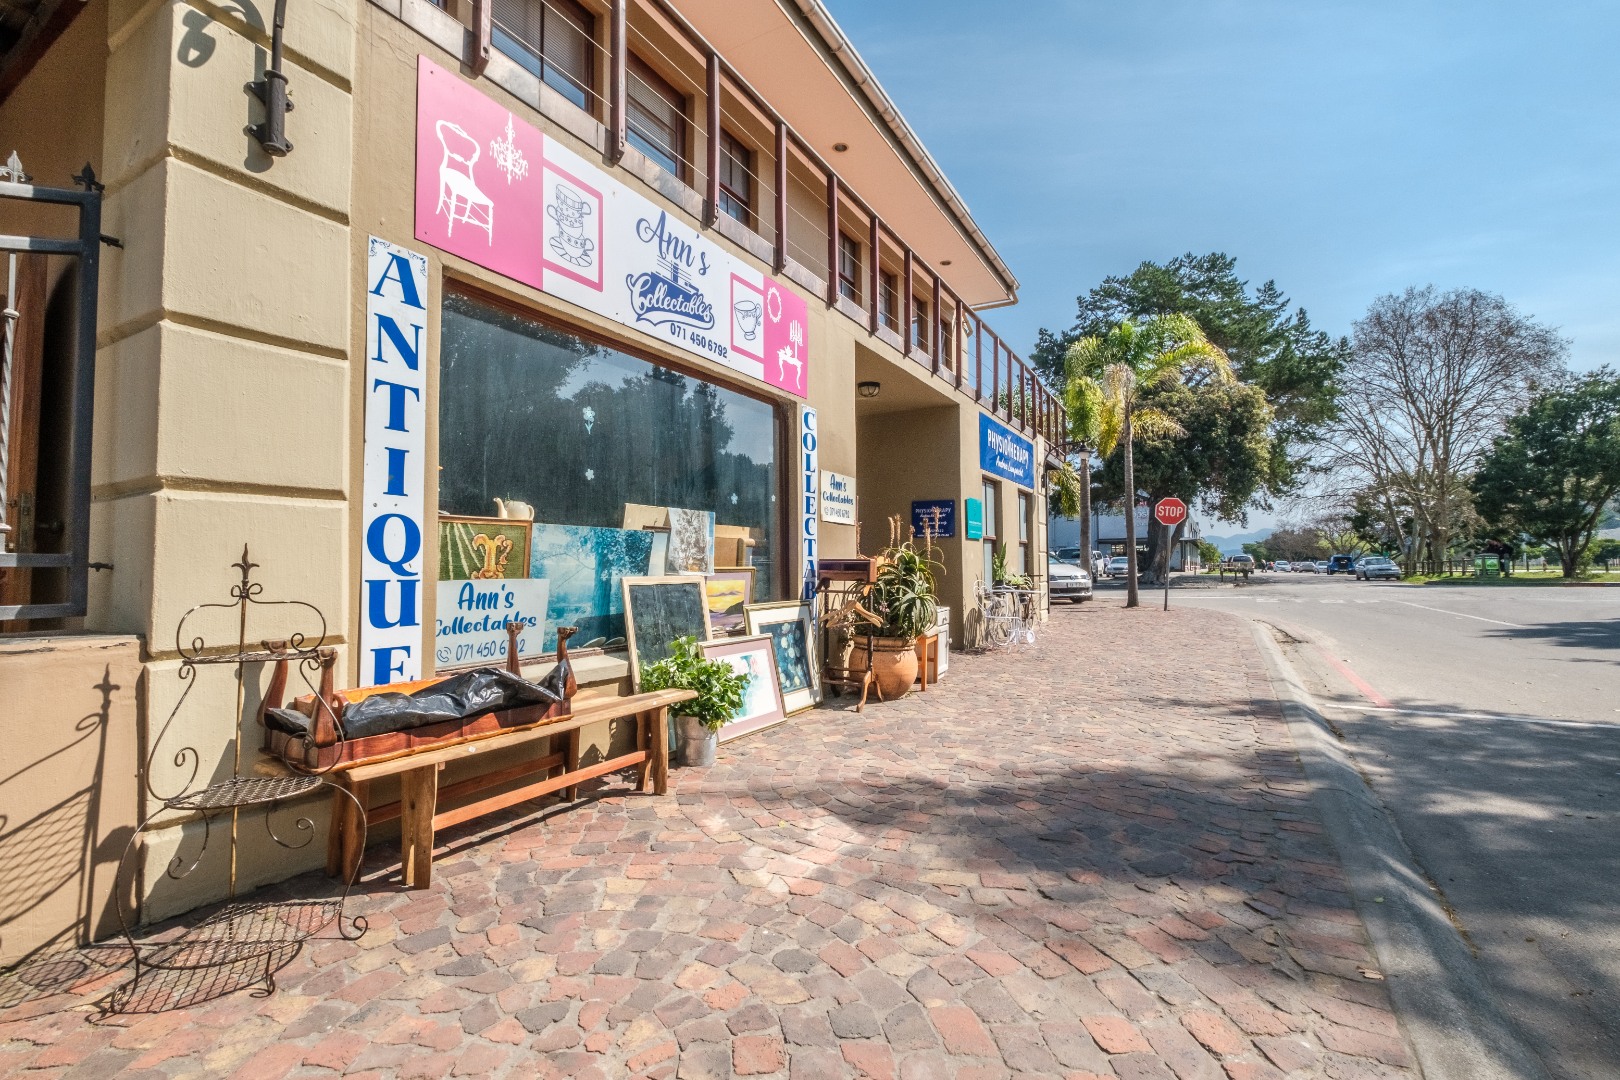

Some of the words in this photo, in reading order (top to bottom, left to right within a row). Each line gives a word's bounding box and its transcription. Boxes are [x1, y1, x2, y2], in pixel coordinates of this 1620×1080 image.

[636, 210, 710, 276] Ann's
[626, 272, 713, 323] Collectables
[670, 323, 687, 340] 071
[690, 331, 706, 349] 450
[707, 340, 728, 358] 6792
[365, 251, 425, 685] ANTIQUE
[830, 474, 846, 492] Ann's
[802, 411, 817, 600] COLLECTAB
[822, 490, 854, 505] Collectables
[1158, 506, 1183, 517] STOP
[458, 582, 515, 611] Ann's
[456, 644, 474, 661] 071
[476, 640, 497, 657] 450
[499, 638, 526, 656] 62
